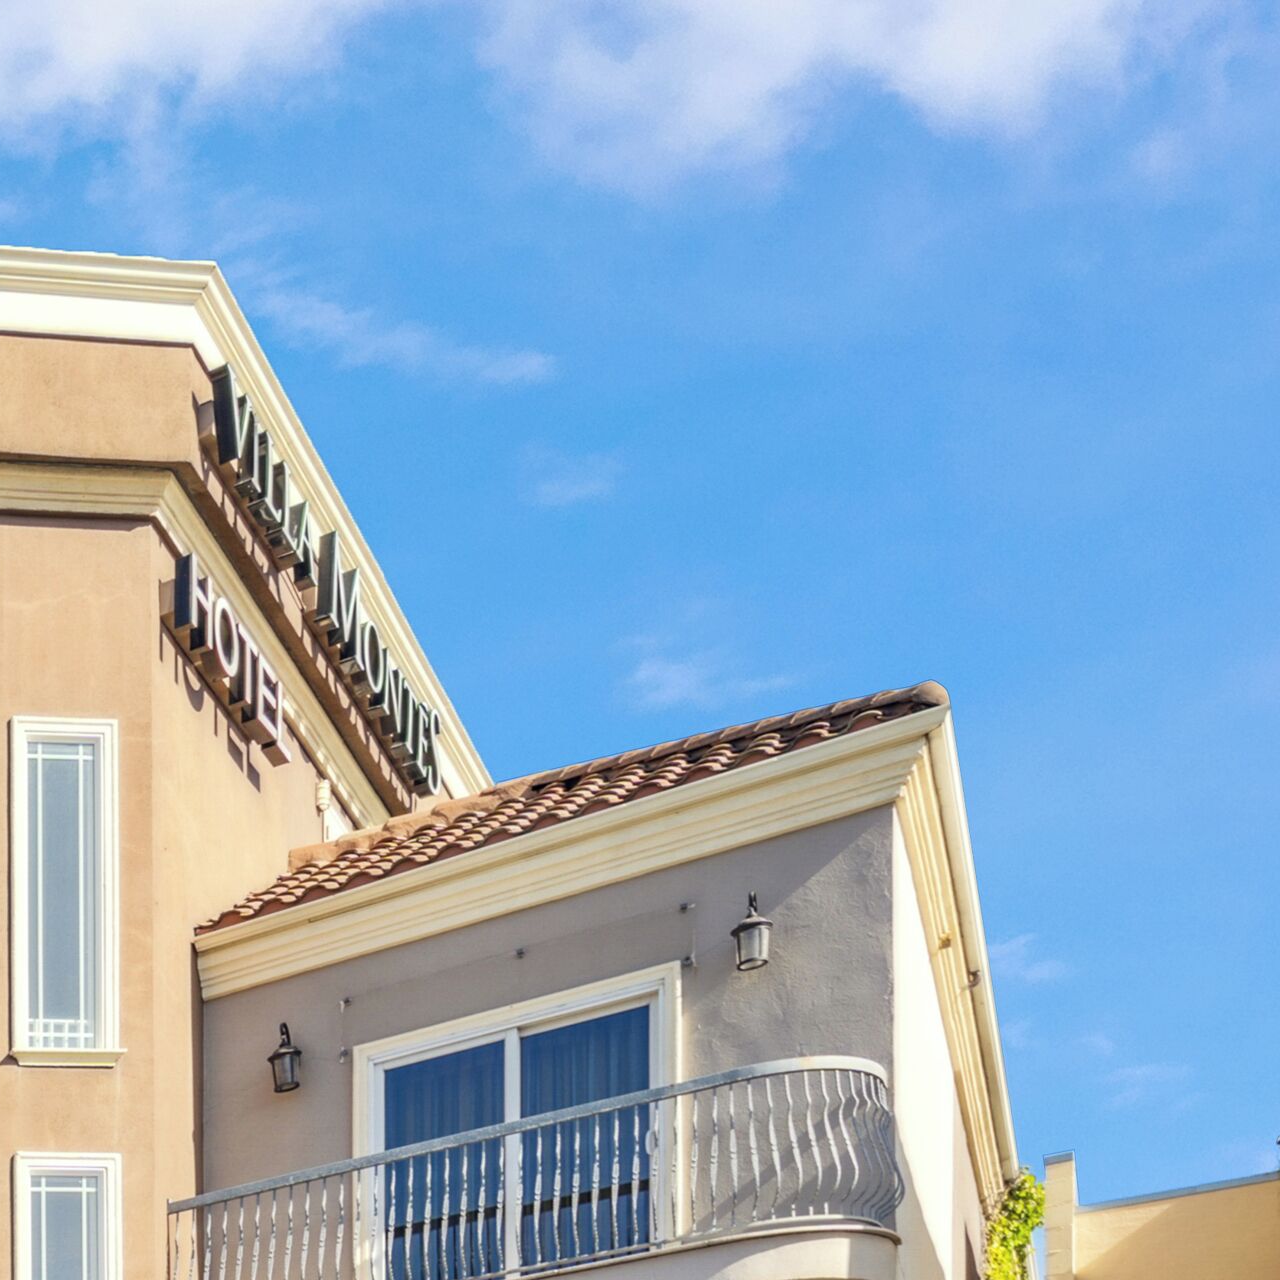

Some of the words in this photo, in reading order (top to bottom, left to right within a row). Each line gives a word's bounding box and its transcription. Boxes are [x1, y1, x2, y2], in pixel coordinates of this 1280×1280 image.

[176, 553, 291, 766] HOTEL
[214, 363, 317, 590] VILLA
[316, 530, 442, 796] MONTES
